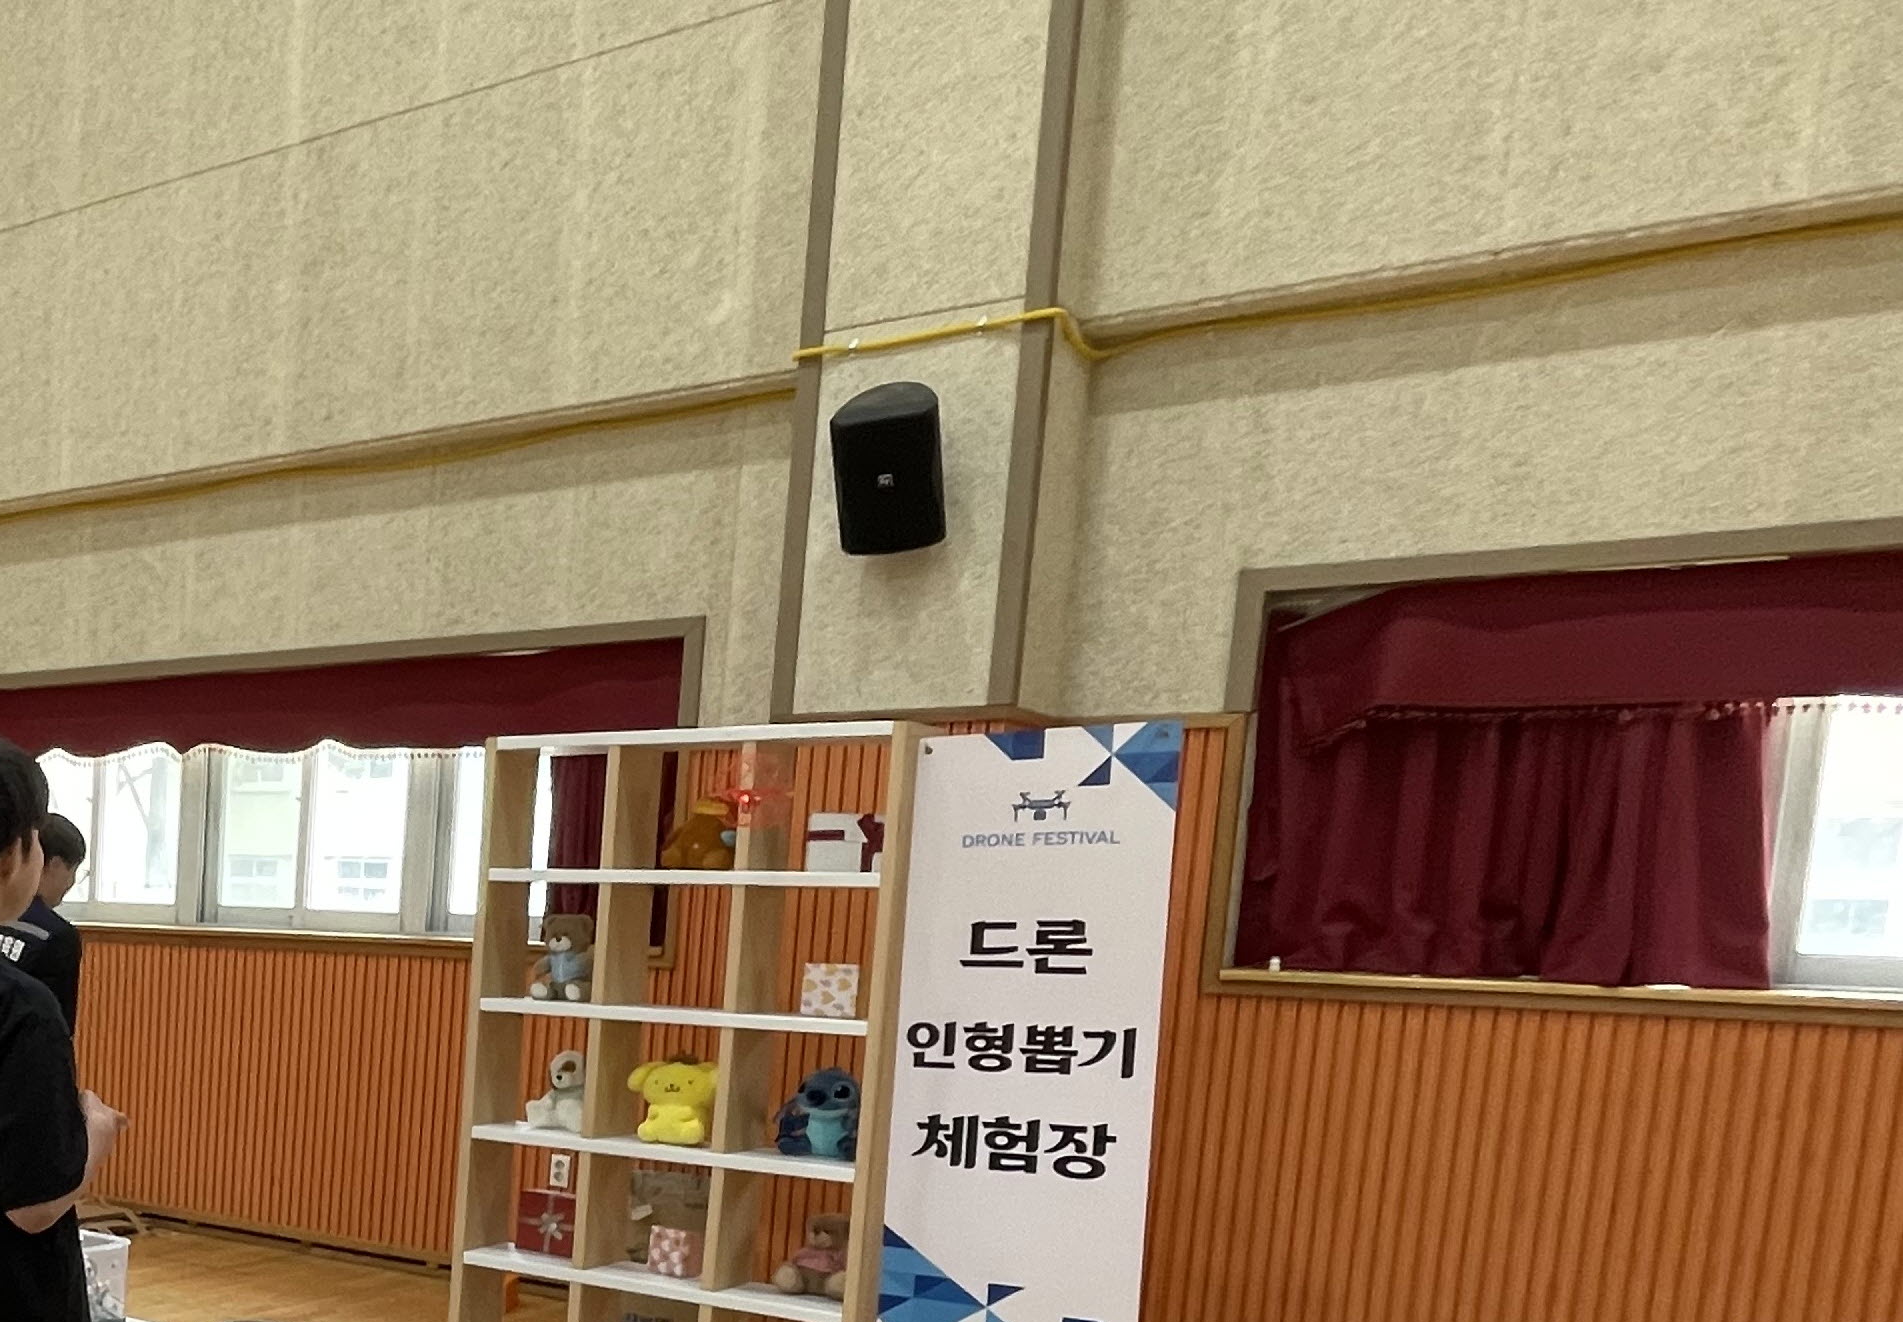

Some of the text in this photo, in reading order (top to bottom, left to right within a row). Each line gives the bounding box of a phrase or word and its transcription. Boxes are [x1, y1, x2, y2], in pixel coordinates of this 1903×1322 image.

[961, 830, 1121, 849] DRONE FESTIVAL
[959, 919, 1093, 975] 드론
[906, 1021, 1137, 1079] 인형뽑기
[911, 1114, 1117, 1180] 체험장
